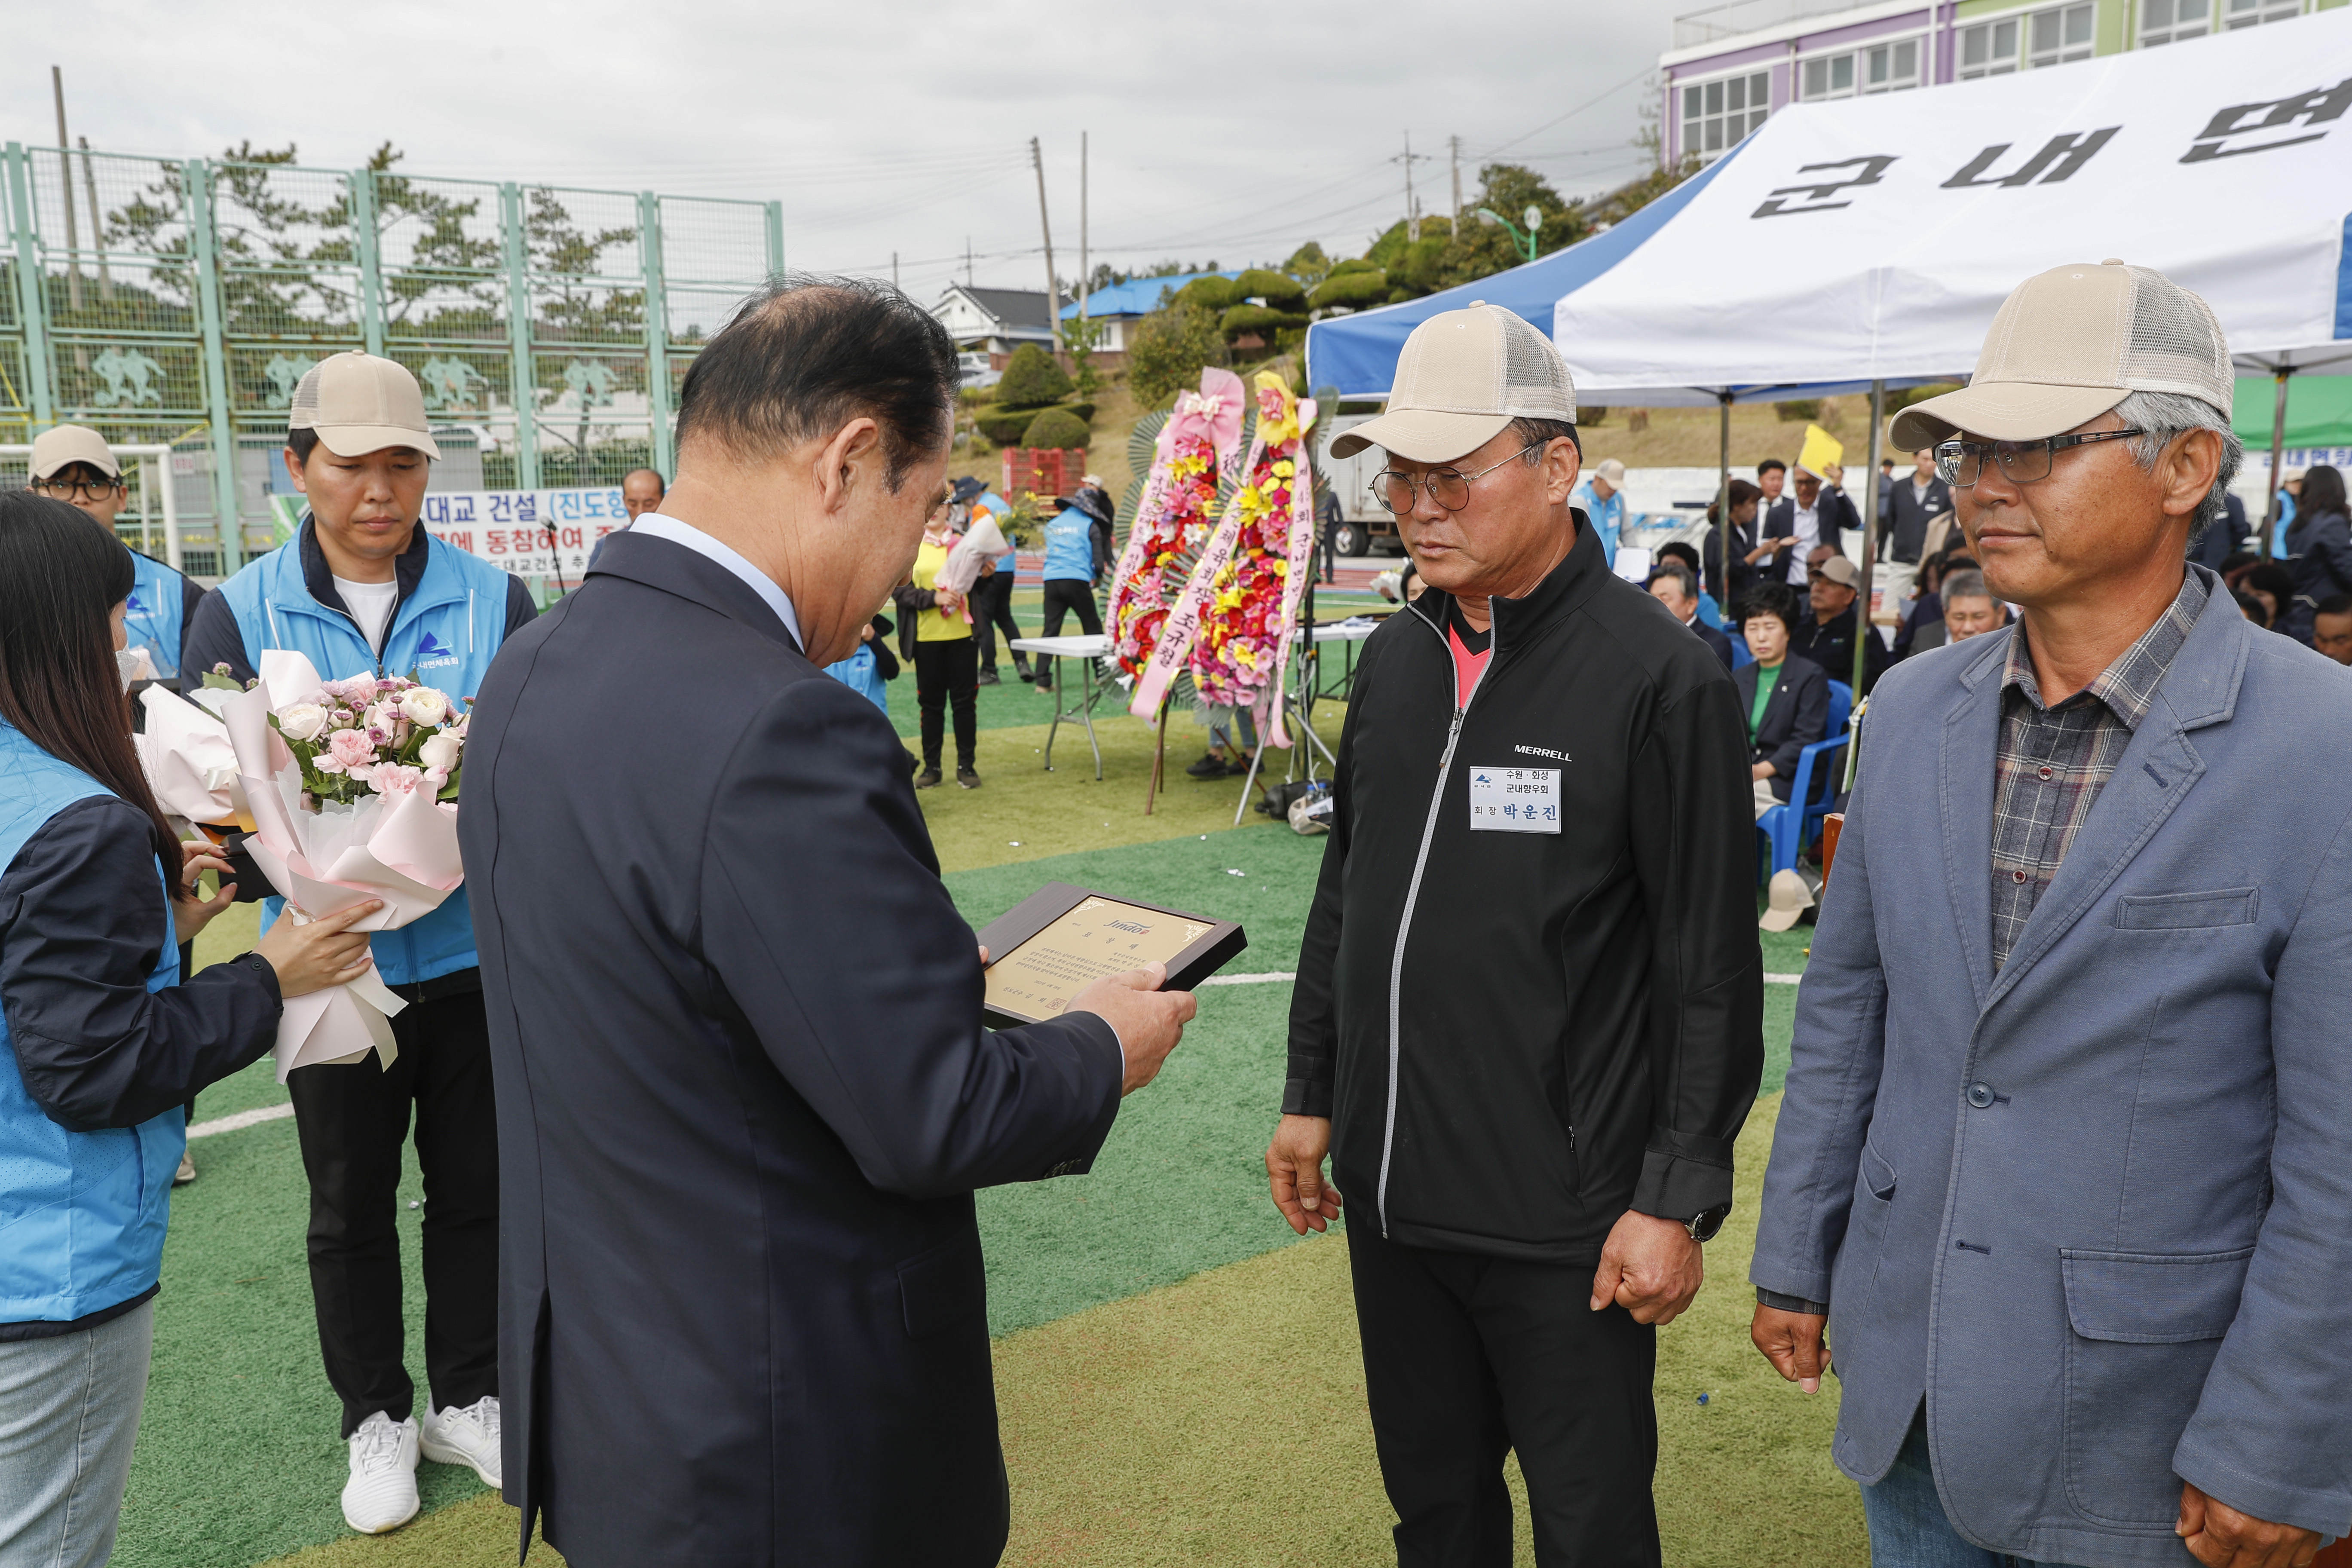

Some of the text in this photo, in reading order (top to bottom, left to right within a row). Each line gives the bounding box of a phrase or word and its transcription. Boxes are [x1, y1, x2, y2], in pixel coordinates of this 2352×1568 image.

[423, 496, 477, 524] 대교
[489, 493, 536, 522] 건설
[487, 527, 583, 554] 동참하여
[1514, 744, 1572, 762] MERRELL
[1507, 770, 1523, 779] 수원
[1532, 770, 1549, 780] 화성
[1506, 784, 1549, 794] 군내향우회
[1103, 920, 1142, 933] Jindo
